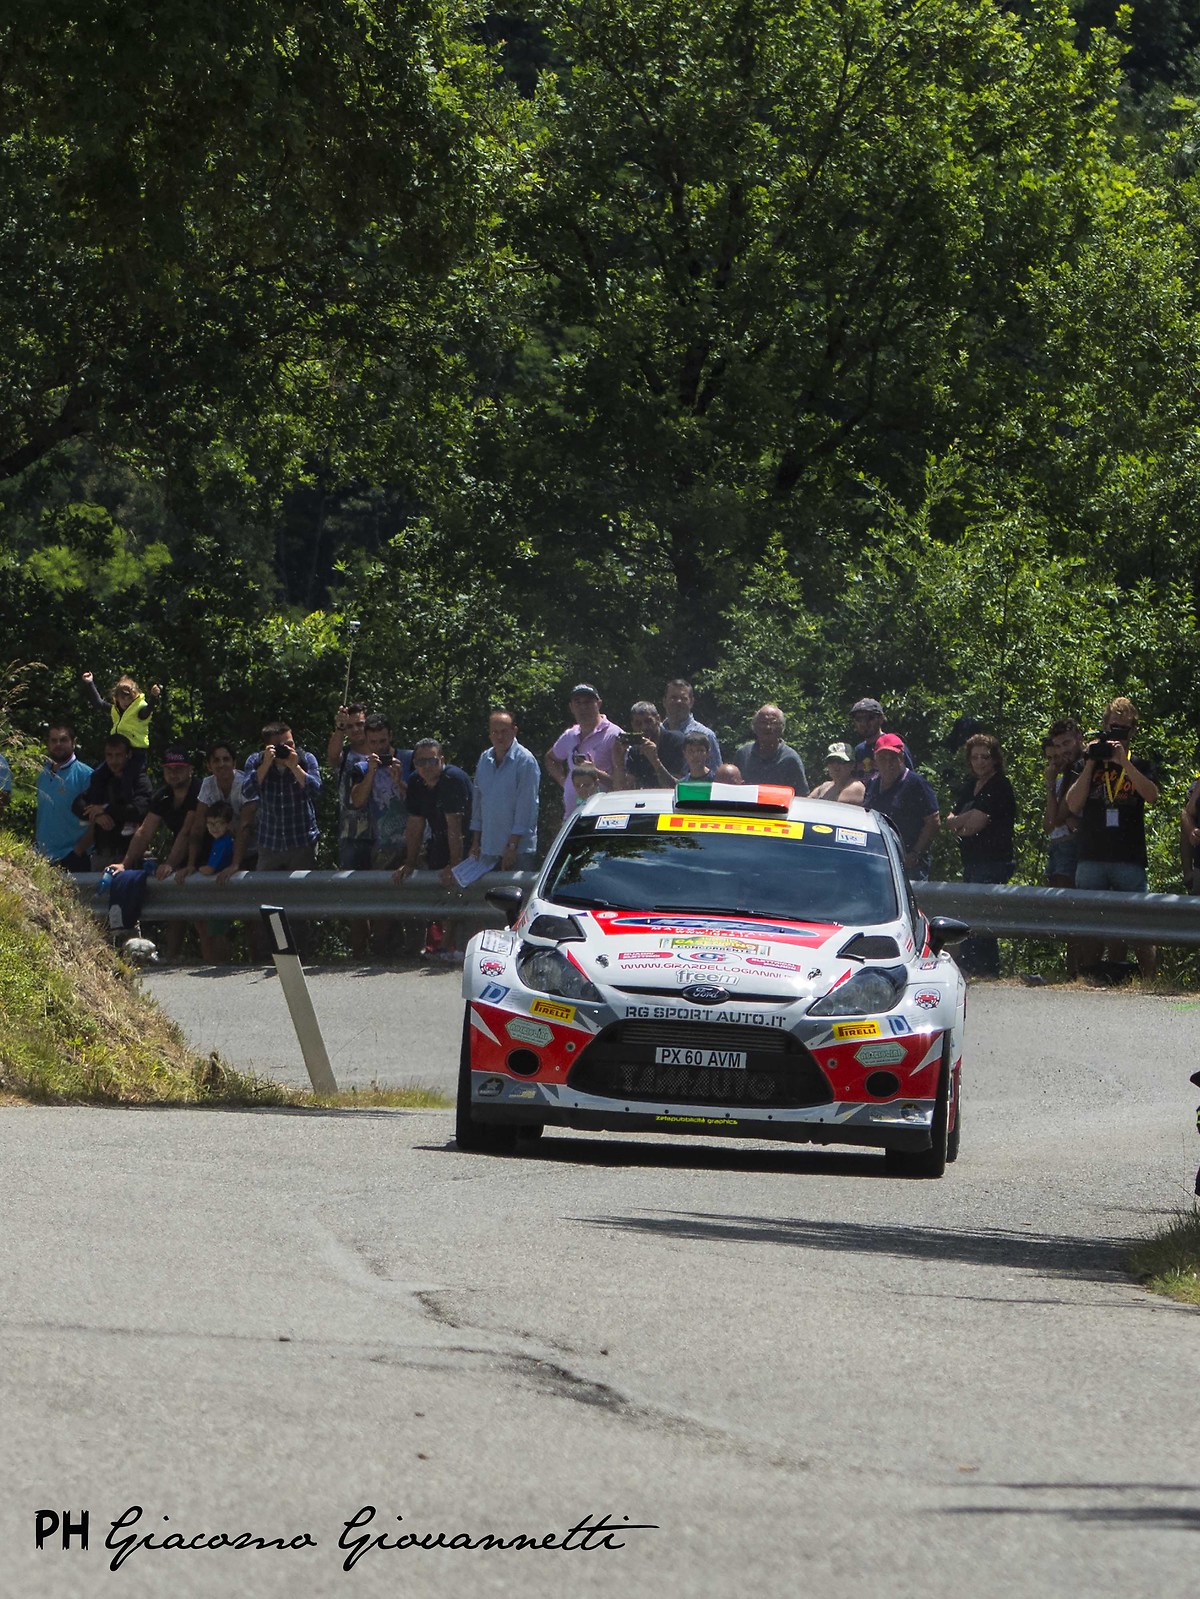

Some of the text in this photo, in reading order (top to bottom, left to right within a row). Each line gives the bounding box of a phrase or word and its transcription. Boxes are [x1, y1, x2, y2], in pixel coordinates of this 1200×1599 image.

[670, 816, 792, 835] PIRELLI
[676, 970, 740, 986] freem
[692, 987, 719, 999] Ford
[533, 1001, 571, 1020] PIRELLI
[625, 1006, 787, 1028] RG SPORT AUTO.IT
[837, 1023, 877, 1037] PIRELLI
[661, 1048, 741, 1067] PX 60 AVM
[707, 1117, 738, 1125] graphics
